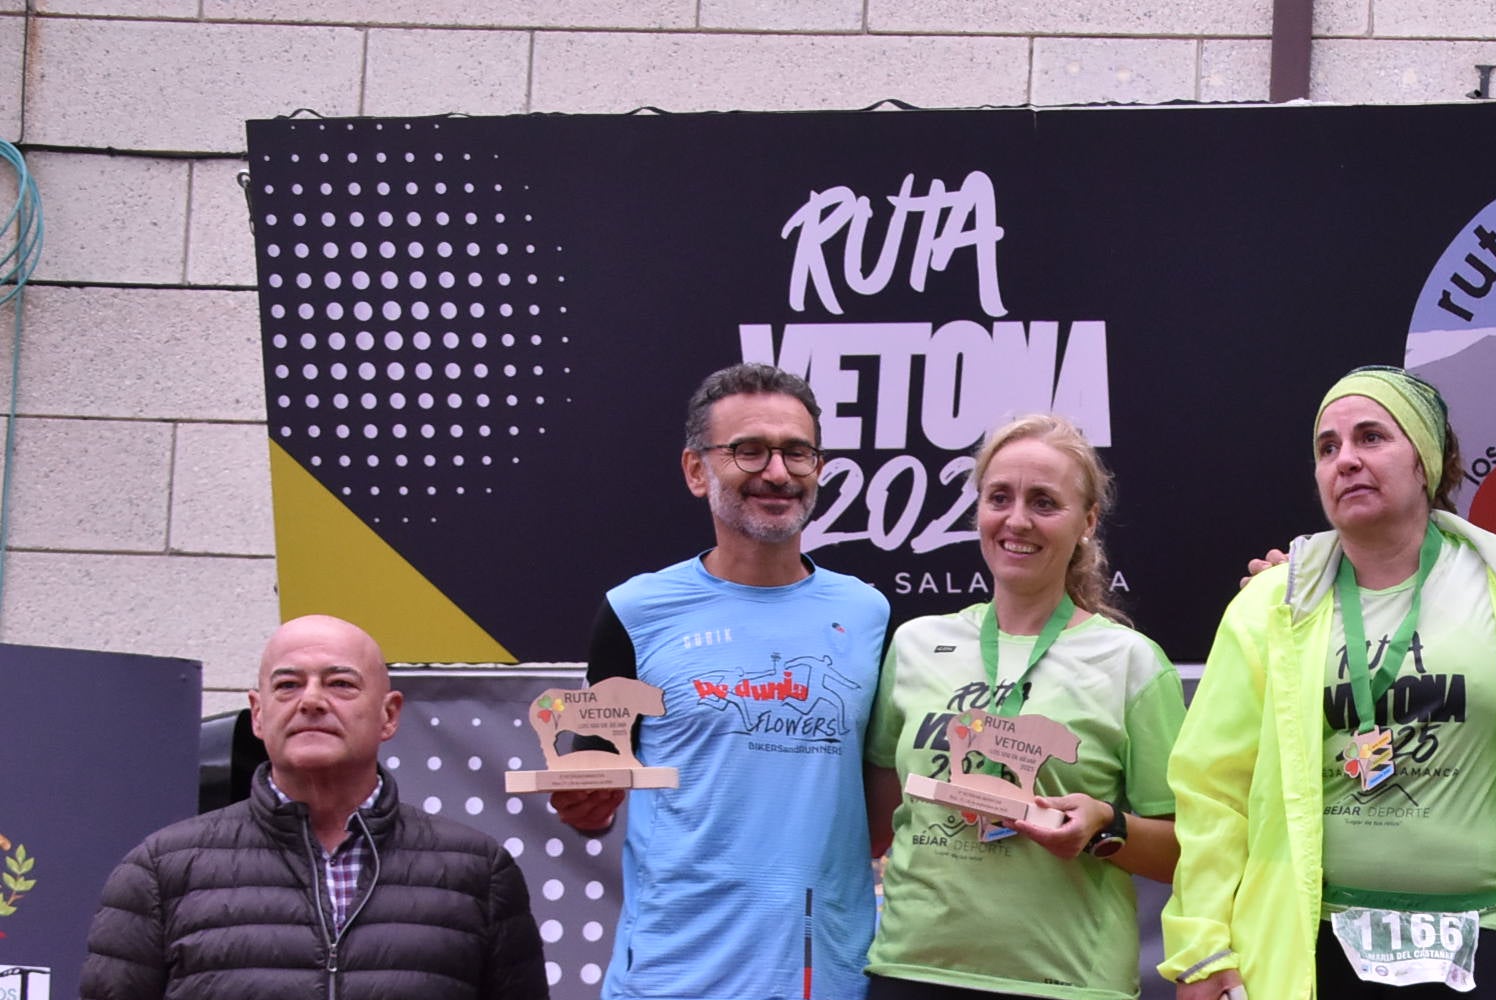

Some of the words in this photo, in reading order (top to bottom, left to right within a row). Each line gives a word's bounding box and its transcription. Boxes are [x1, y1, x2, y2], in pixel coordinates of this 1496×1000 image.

[781, 170, 1009, 318] RUTA
[564, 692, 598, 704] RUTA
[580, 707, 631, 720] VETONA
[754, 710, 838, 737] FLOWERS
[984, 715, 1016, 733] RUTA
[994, 735, 1042, 756] VETONA
[1367, 806, 1431, 818] DEPORTE
[911, 830, 948, 847] BÉJAR
[1351, 911, 1464, 952] 1166
